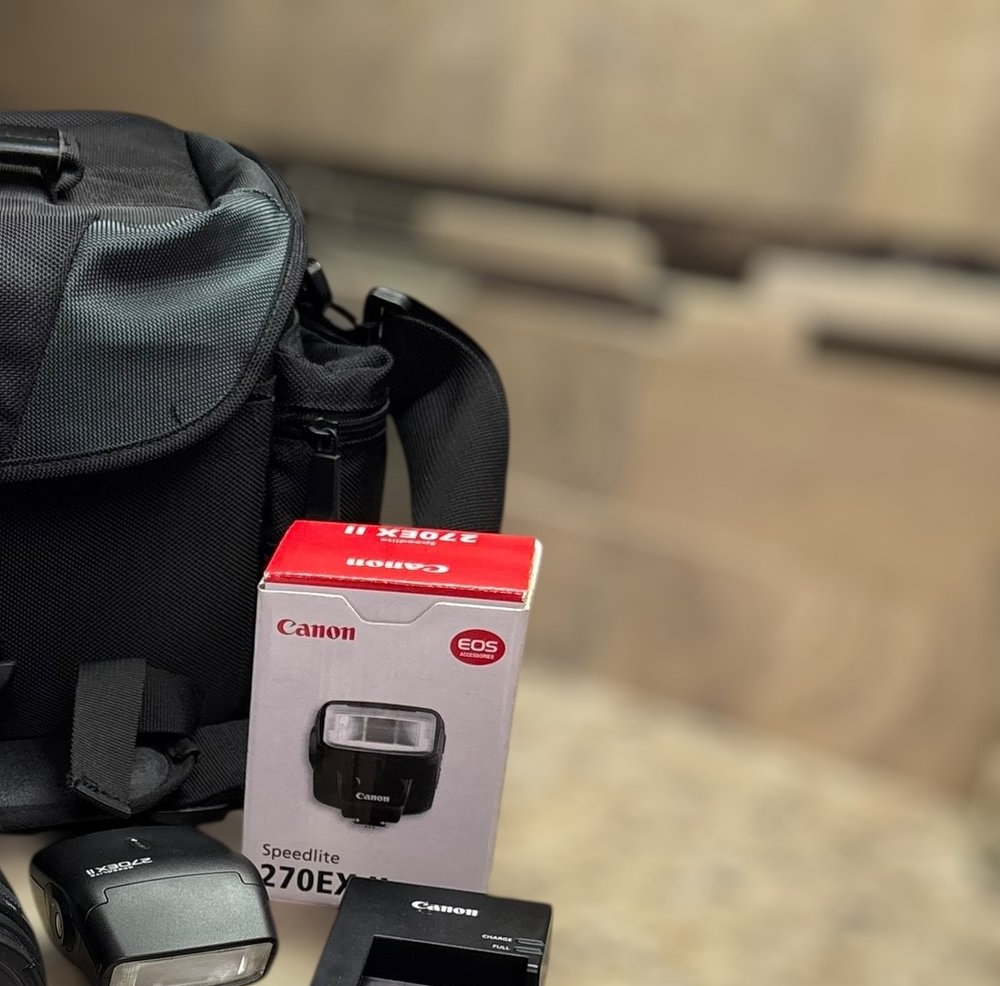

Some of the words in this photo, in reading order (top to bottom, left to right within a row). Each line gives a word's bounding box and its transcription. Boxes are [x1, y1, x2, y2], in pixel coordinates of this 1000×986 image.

[376, 527, 479, 544] 270EX
[345, 557, 450, 574] Canon
[276, 618, 356, 641] Canon
[457, 637, 499, 653] EOS
[355, 791, 391, 803] Canon
[262, 843, 341, 864] Speedlite
[260, 863, 356, 896] 270EX
[411, 900, 479, 917] Canon
[492, 943, 511, 951] FULL
